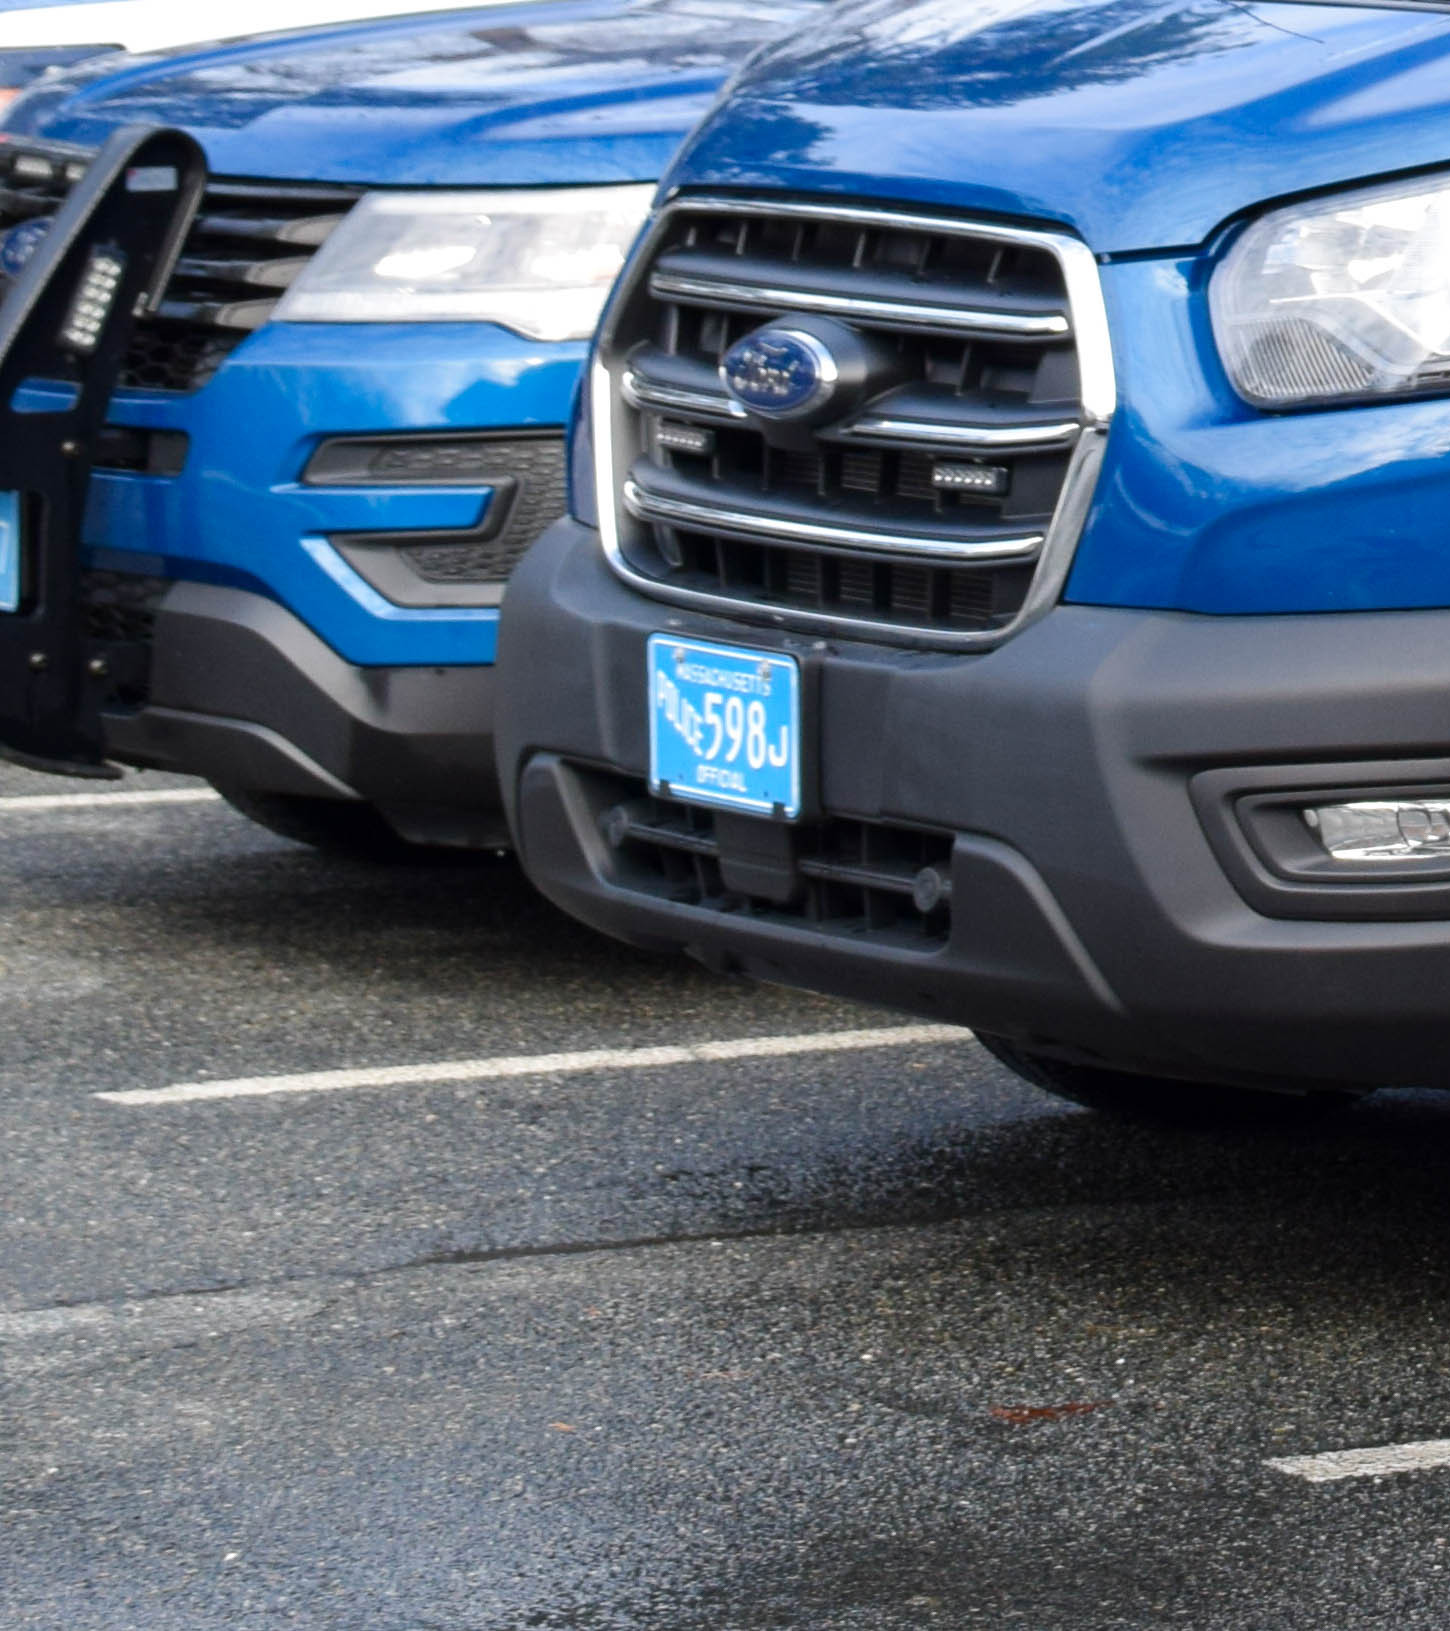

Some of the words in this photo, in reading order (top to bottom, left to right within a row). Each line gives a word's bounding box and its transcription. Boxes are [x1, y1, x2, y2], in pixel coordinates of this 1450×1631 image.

[657, 669, 704, 757] POLICE
[703, 691, 789, 770] 598J
[696, 764, 748, 793] OFFICIAL
